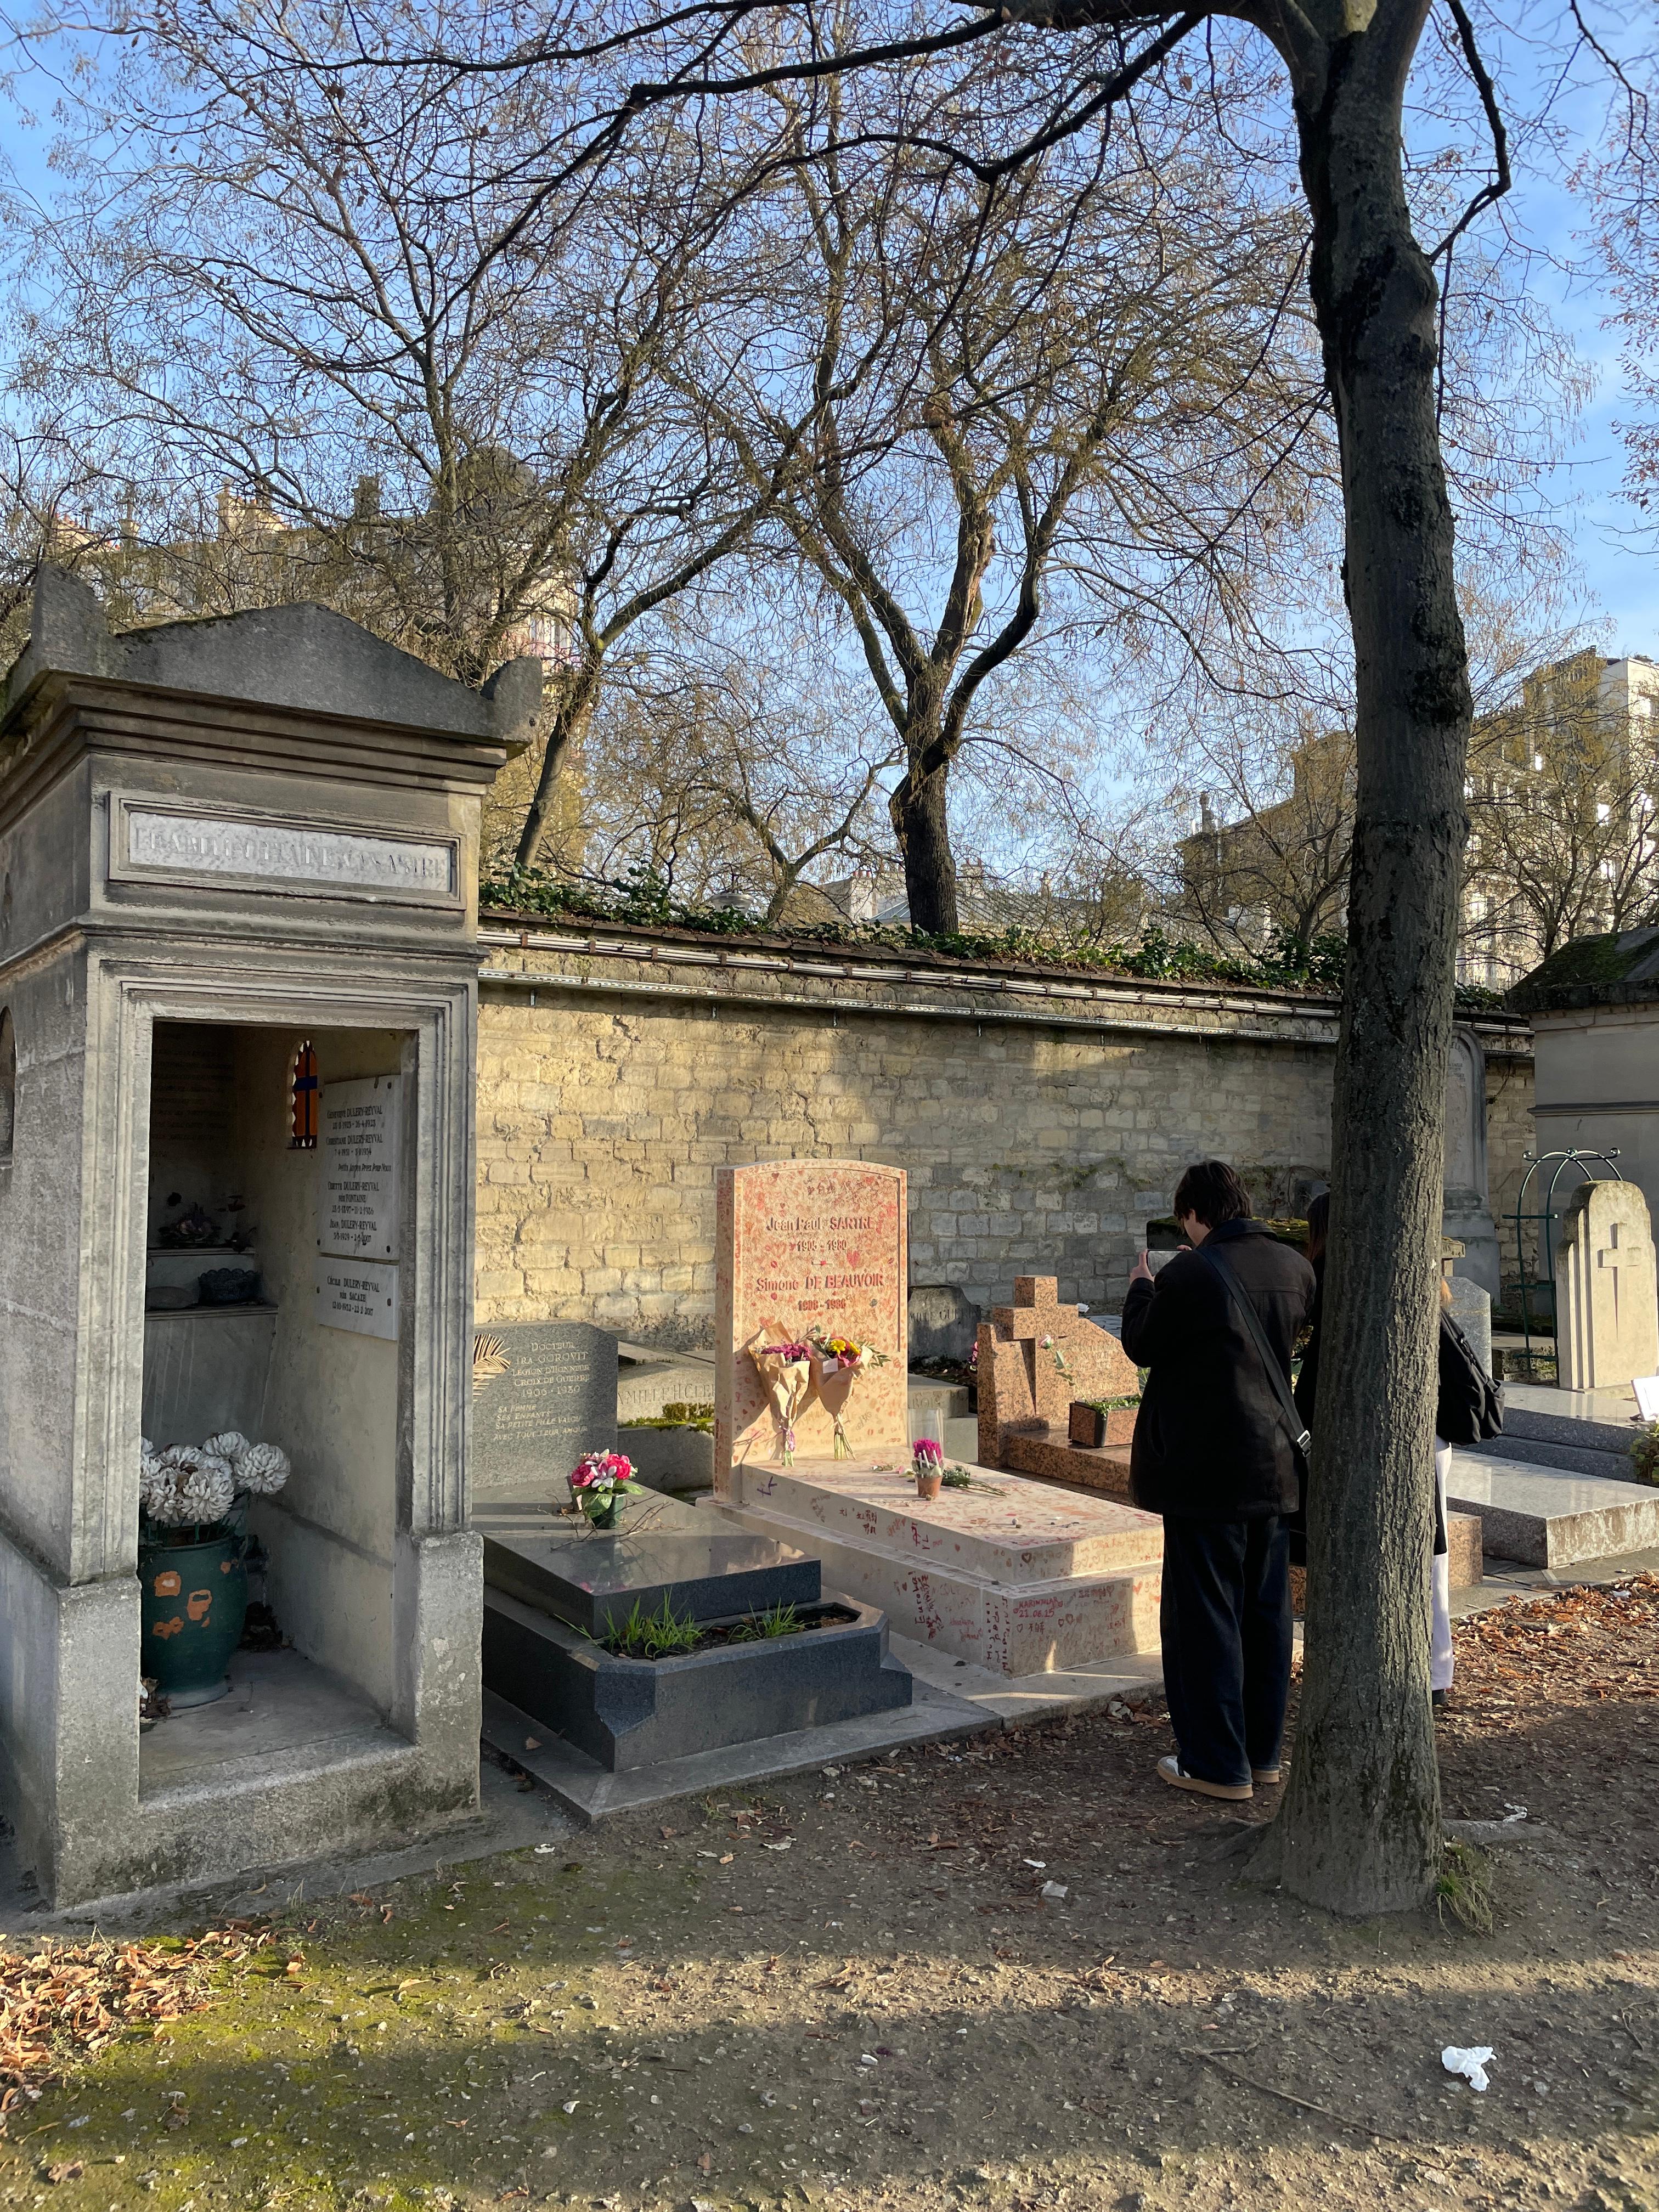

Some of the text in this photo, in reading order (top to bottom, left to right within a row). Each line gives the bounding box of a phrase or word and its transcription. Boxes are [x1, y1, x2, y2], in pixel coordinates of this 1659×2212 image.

[766, 1216, 876, 1231] Jean Paul SARTRE
[797, 1240, 817, 1251] 1905
[827, 1239, 848, 1251] 1980
[757, 1273, 884, 1291] Simone DE BEAUVOIR
[798, 1300, 819, 1311] 1908
[531, 1342, 575, 1352] DOCTEUR
[515, 1411, 550, 1420] ENFANTS
